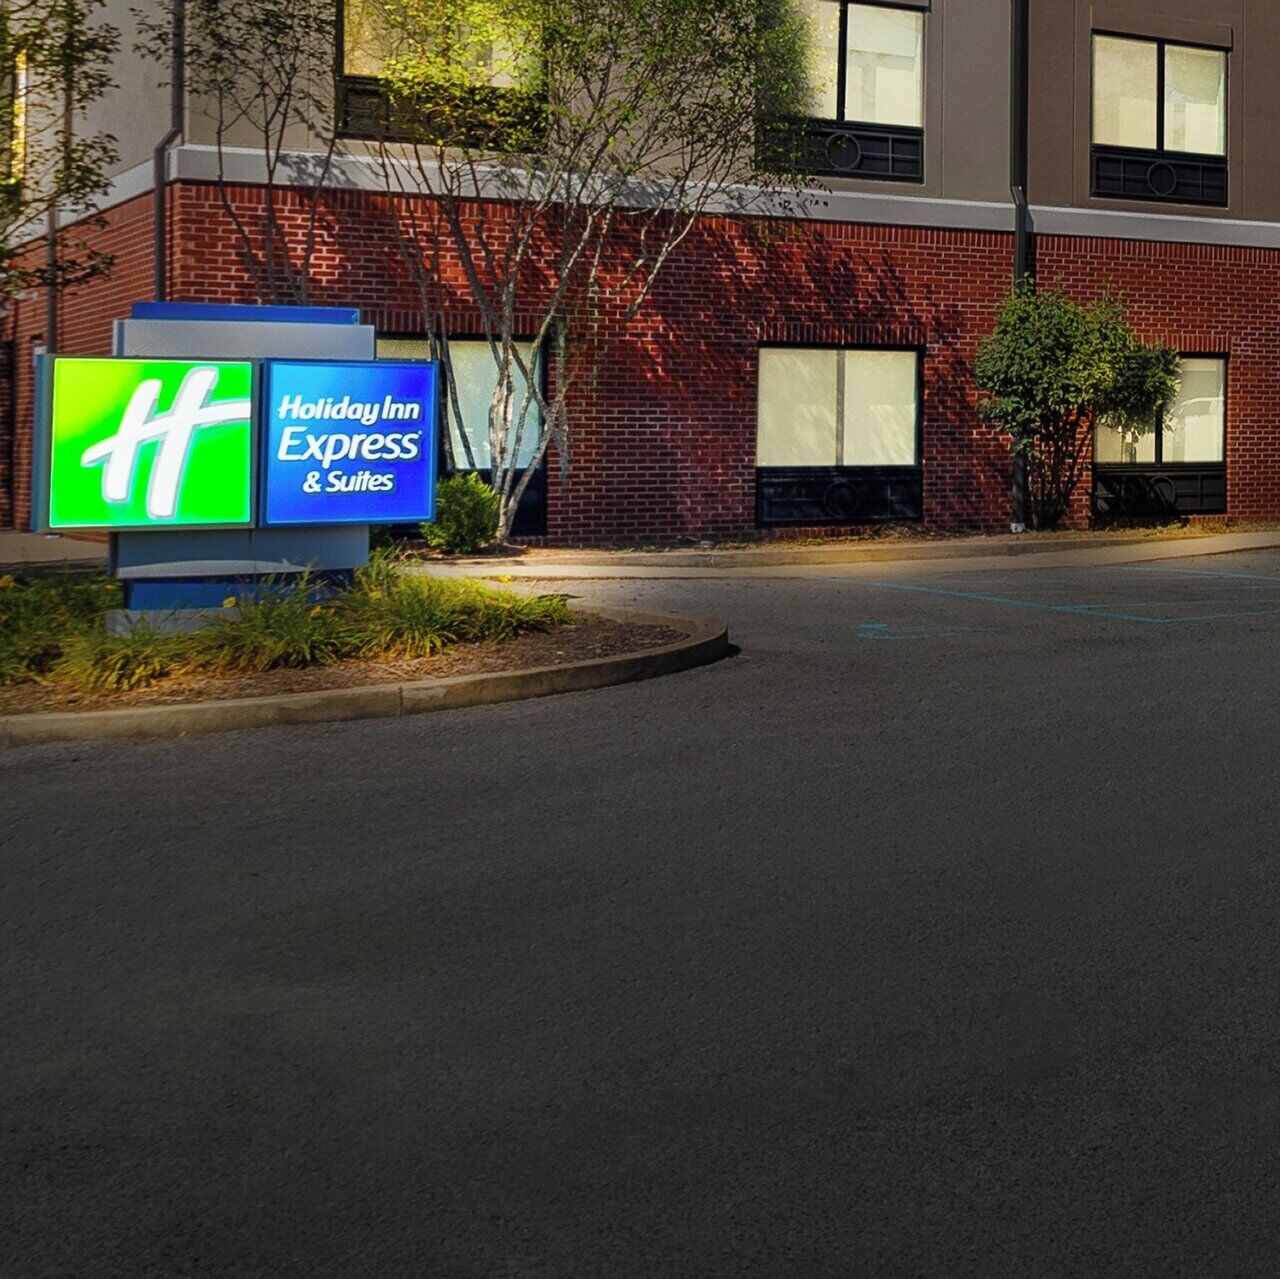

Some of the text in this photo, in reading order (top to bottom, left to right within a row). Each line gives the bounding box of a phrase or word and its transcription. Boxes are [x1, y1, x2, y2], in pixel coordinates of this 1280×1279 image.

[277, 394, 420, 425] Holiday Inn
[277, 426, 420, 469] Express
[302, 470, 394, 493] & Suites
